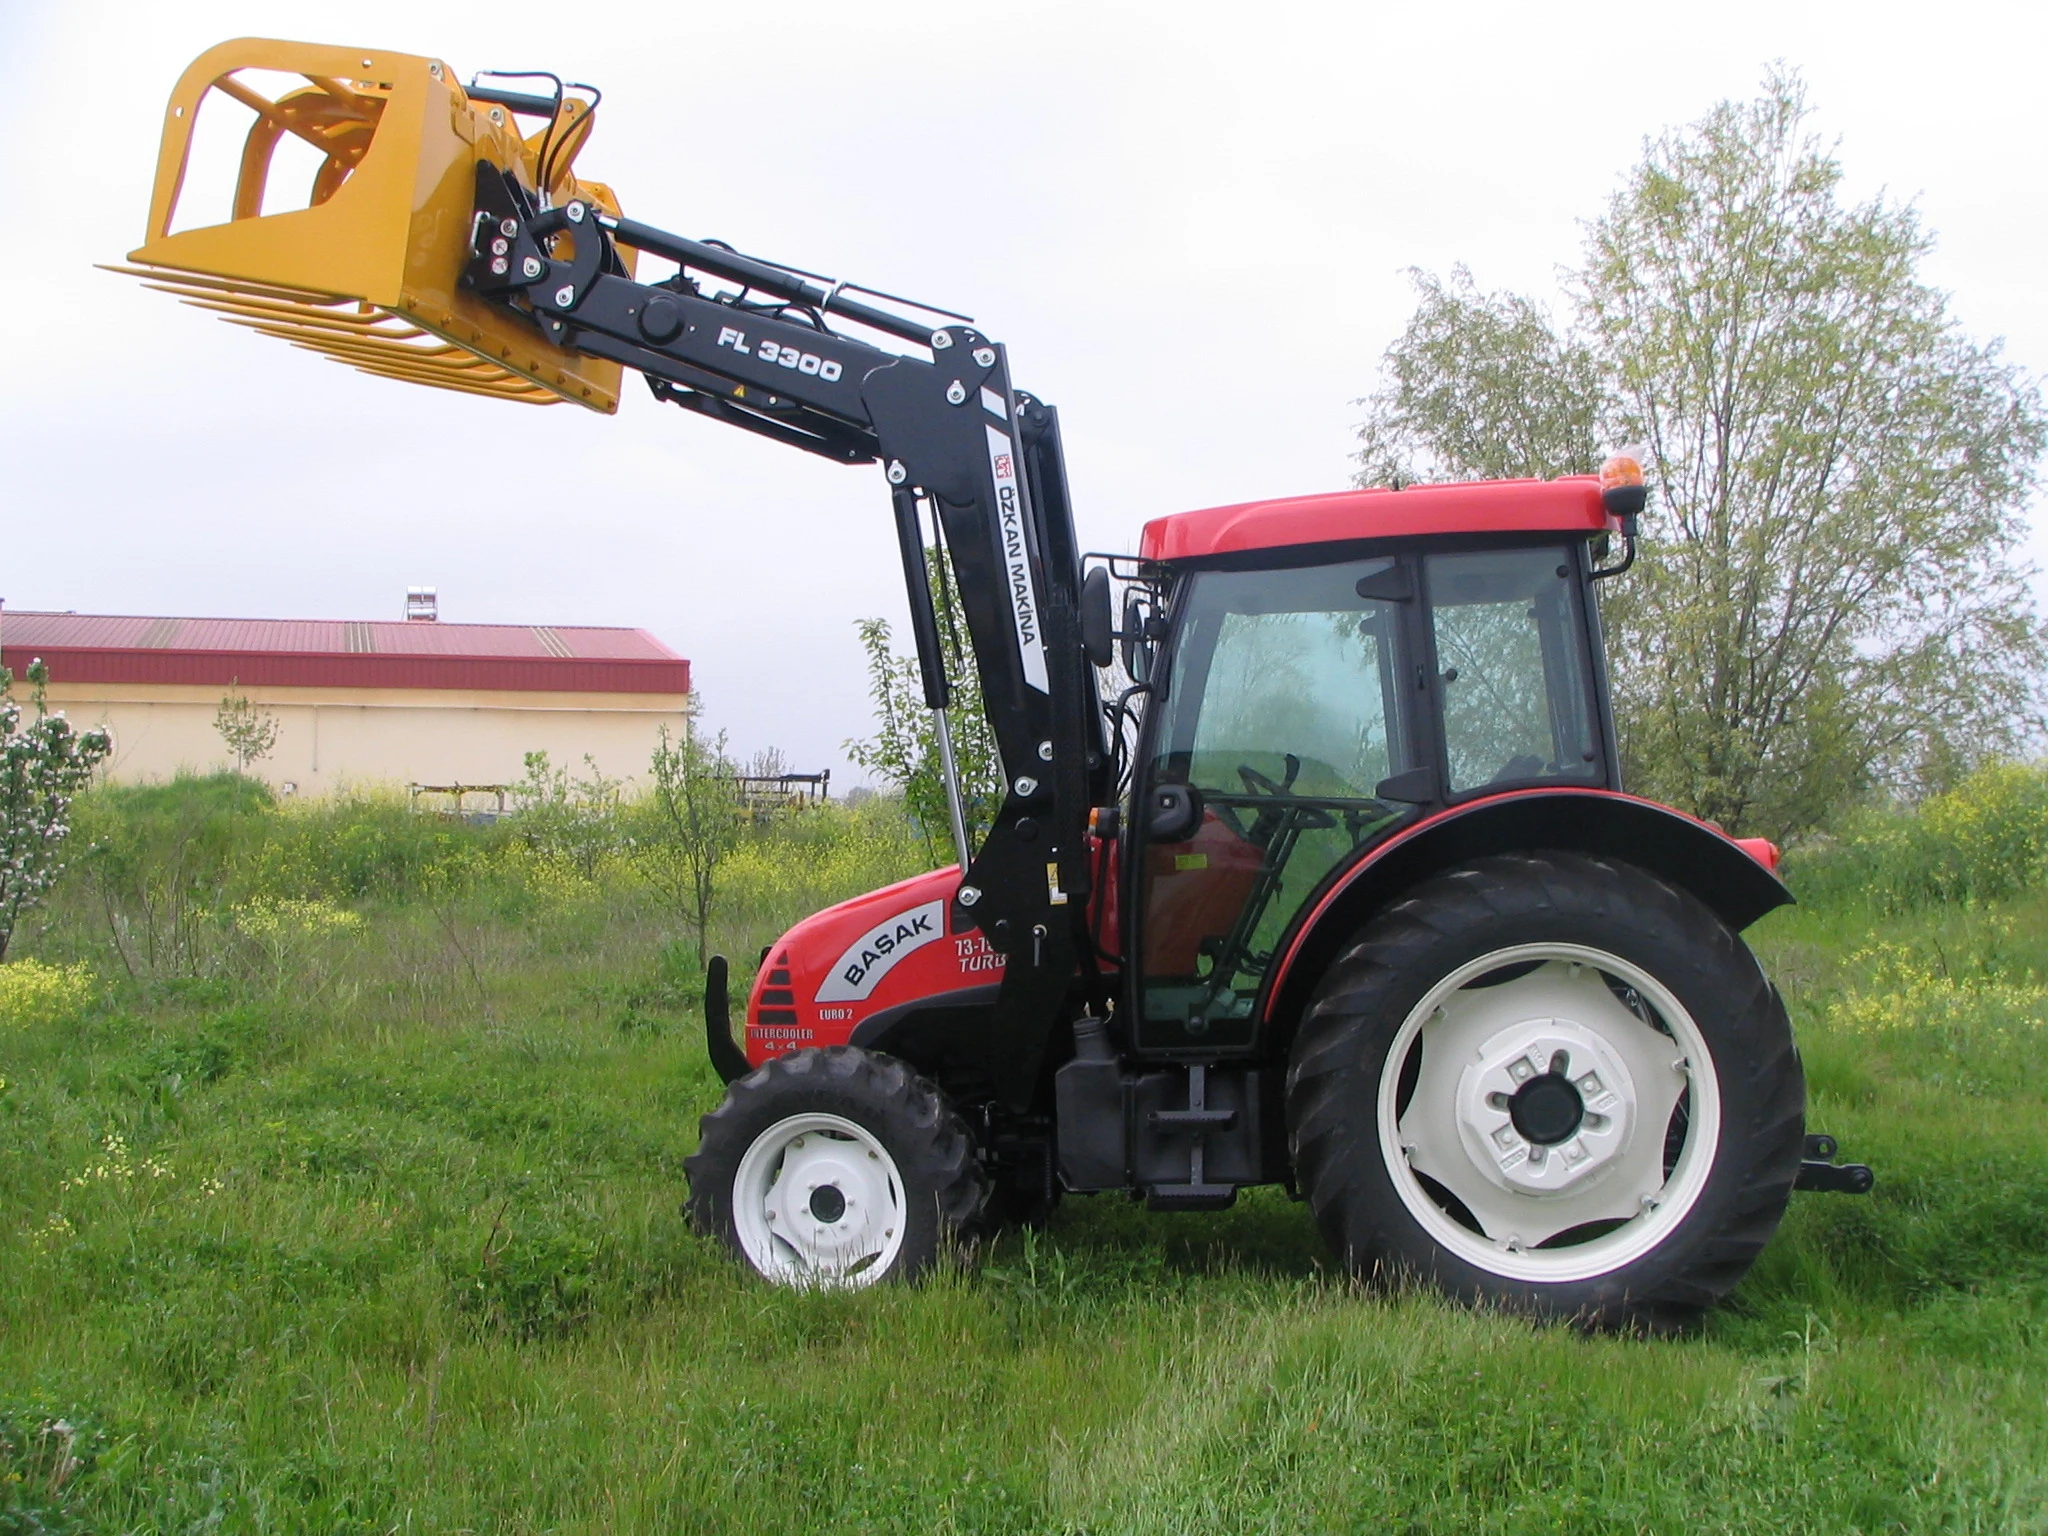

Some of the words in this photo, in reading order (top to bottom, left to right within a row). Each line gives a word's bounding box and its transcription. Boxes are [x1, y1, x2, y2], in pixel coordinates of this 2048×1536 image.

[717, 326, 751, 355] FL
[758, 340, 843, 382] 3300
[999, 486, 1022, 559] ÖZKAN
[1011, 564, 1035, 646] MAKİNA
[843, 913, 933, 987] BAŞAK
[750, 1028, 814, 1039] INTERCOOLER
[819, 1009, 845, 1020] EURO
[846, 1008, 853, 1020] 2
